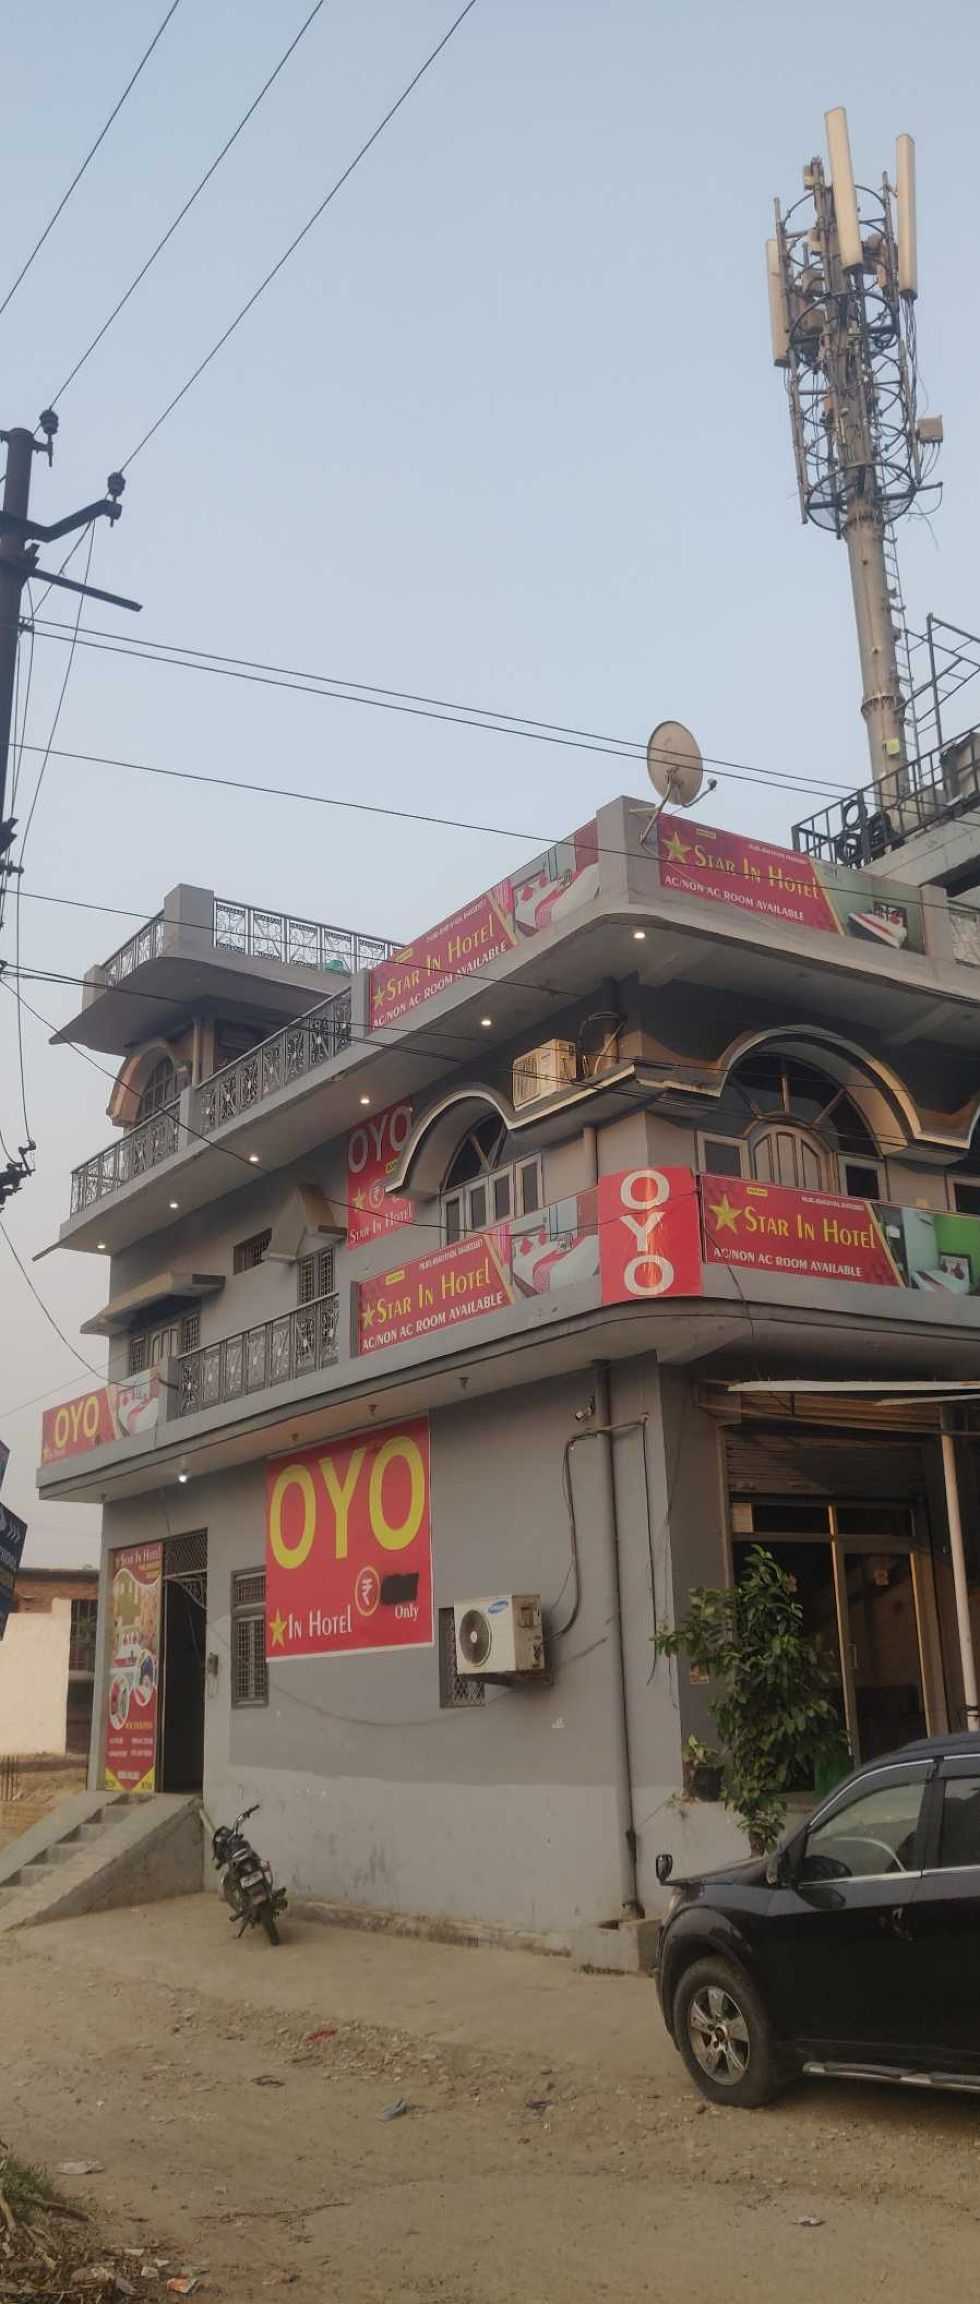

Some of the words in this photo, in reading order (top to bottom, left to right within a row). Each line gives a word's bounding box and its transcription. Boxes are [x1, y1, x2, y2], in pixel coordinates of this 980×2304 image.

[694, 844, 736, 875] STAR
[768, 866, 819, 900] HOTEL
[724, 890, 754, 907] ROOM
[756, 899, 804, 921] AVAILABLE
[386, 970, 420, 1001] STAR
[427, 954, 441, 976] IN
[448, 914, 495, 962] HOTEL
[424, 974, 453, 999] ROOM
[347, 1104, 413, 1174] OYO
[619, 1169, 675, 1297] OYO
[744, 1206, 789, 1238] STAR
[797, 1215, 816, 1241] IN
[823, 1217, 876, 1249] HOTEL
[376, 1296, 411, 1323] STAR
[418, 1283, 433, 1310] IN
[441, 1257, 491, 1300] HOTEL
[758, 1253, 774, 1265] AC
[775, 1255, 808, 1271] ROOM
[810, 1261, 864, 1277] AVAILABLE
[362, 1329, 398, 1351] AC/NON
[399, 1324, 414, 1338] AC
[416, 1311, 446, 1332] ROOM
[449, 1291, 504, 1320] AVAILABLE
[55, 1395, 100, 1449] OYO
[269, 1435, 426, 1569] OYO
[288, 1612, 302, 1640] IN
[309, 1603, 353, 1638] HOTEL
[394, 1603, 419, 1622] Only
